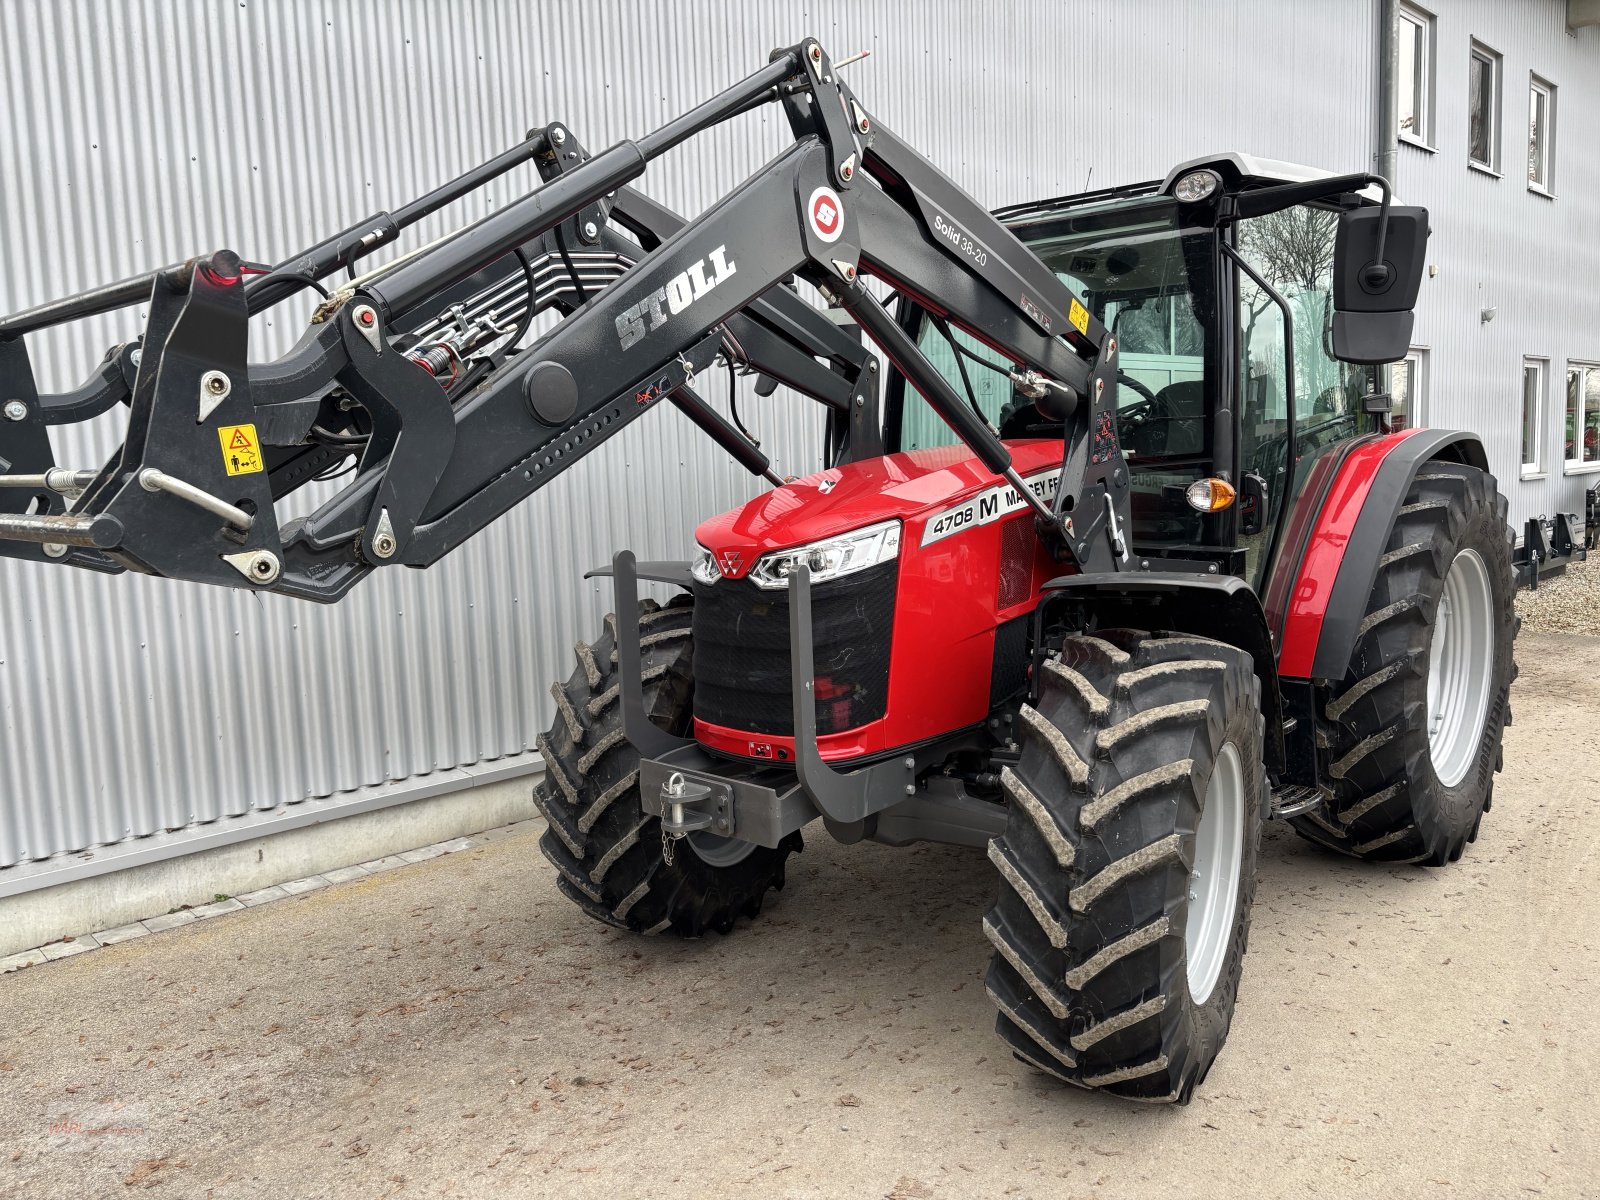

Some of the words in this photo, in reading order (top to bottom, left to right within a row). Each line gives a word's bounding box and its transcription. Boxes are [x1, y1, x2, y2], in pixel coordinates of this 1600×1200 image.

[934, 215, 961, 246] Solid
[960, 237, 987, 267] 38-20
[615, 244, 737, 352] STOLL
[933, 507, 973, 534] 4708
[979, 493, 998, 520] M
